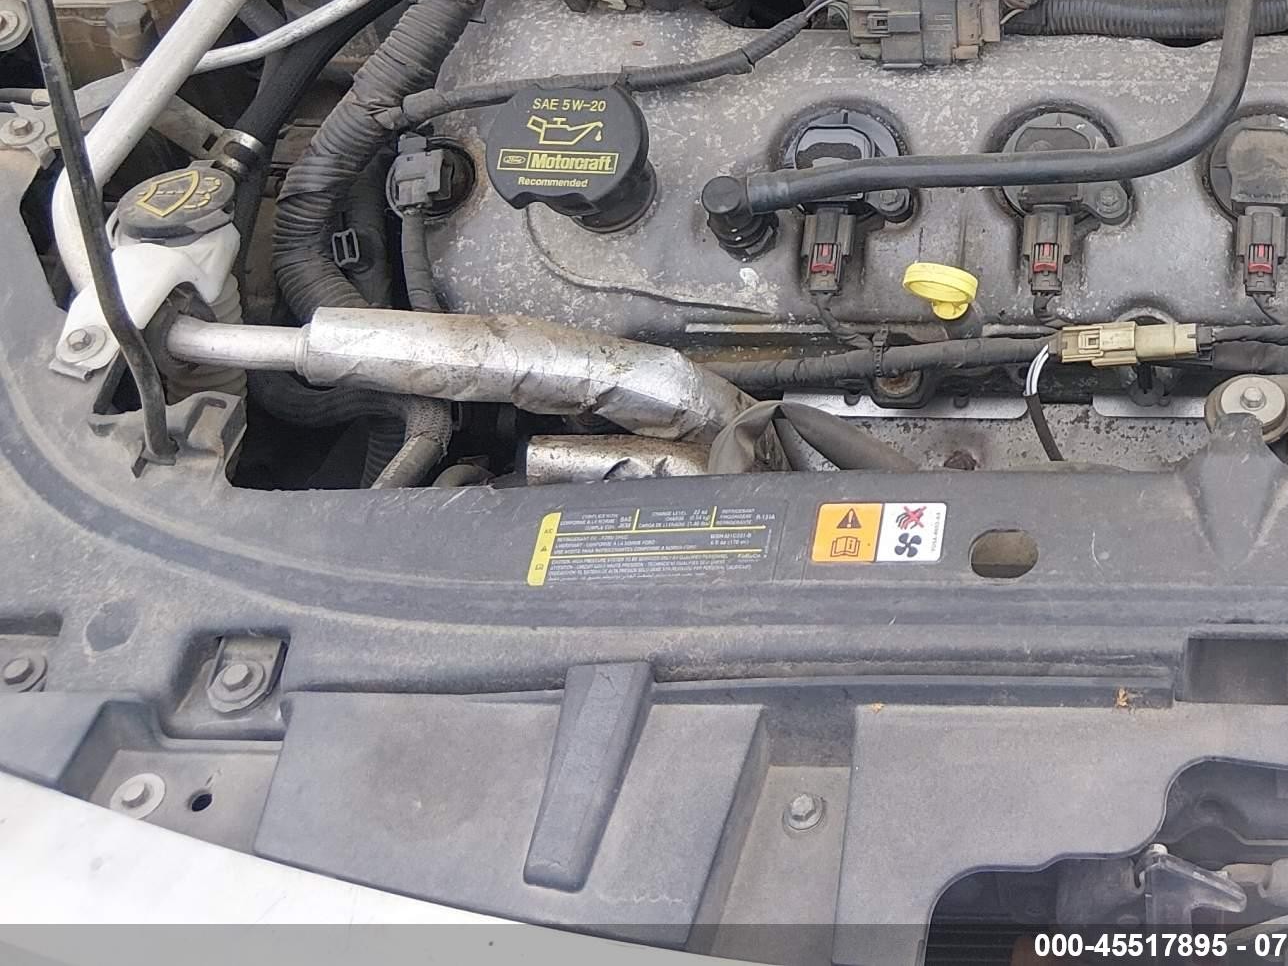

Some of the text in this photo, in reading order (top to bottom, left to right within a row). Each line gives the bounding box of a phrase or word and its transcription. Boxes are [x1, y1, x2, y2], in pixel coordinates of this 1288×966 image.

[532, 98, 606, 112] SAE 5W-20
[531, 153, 611, 171] Motorcraft
[518, 177, 588, 187] Recommended
